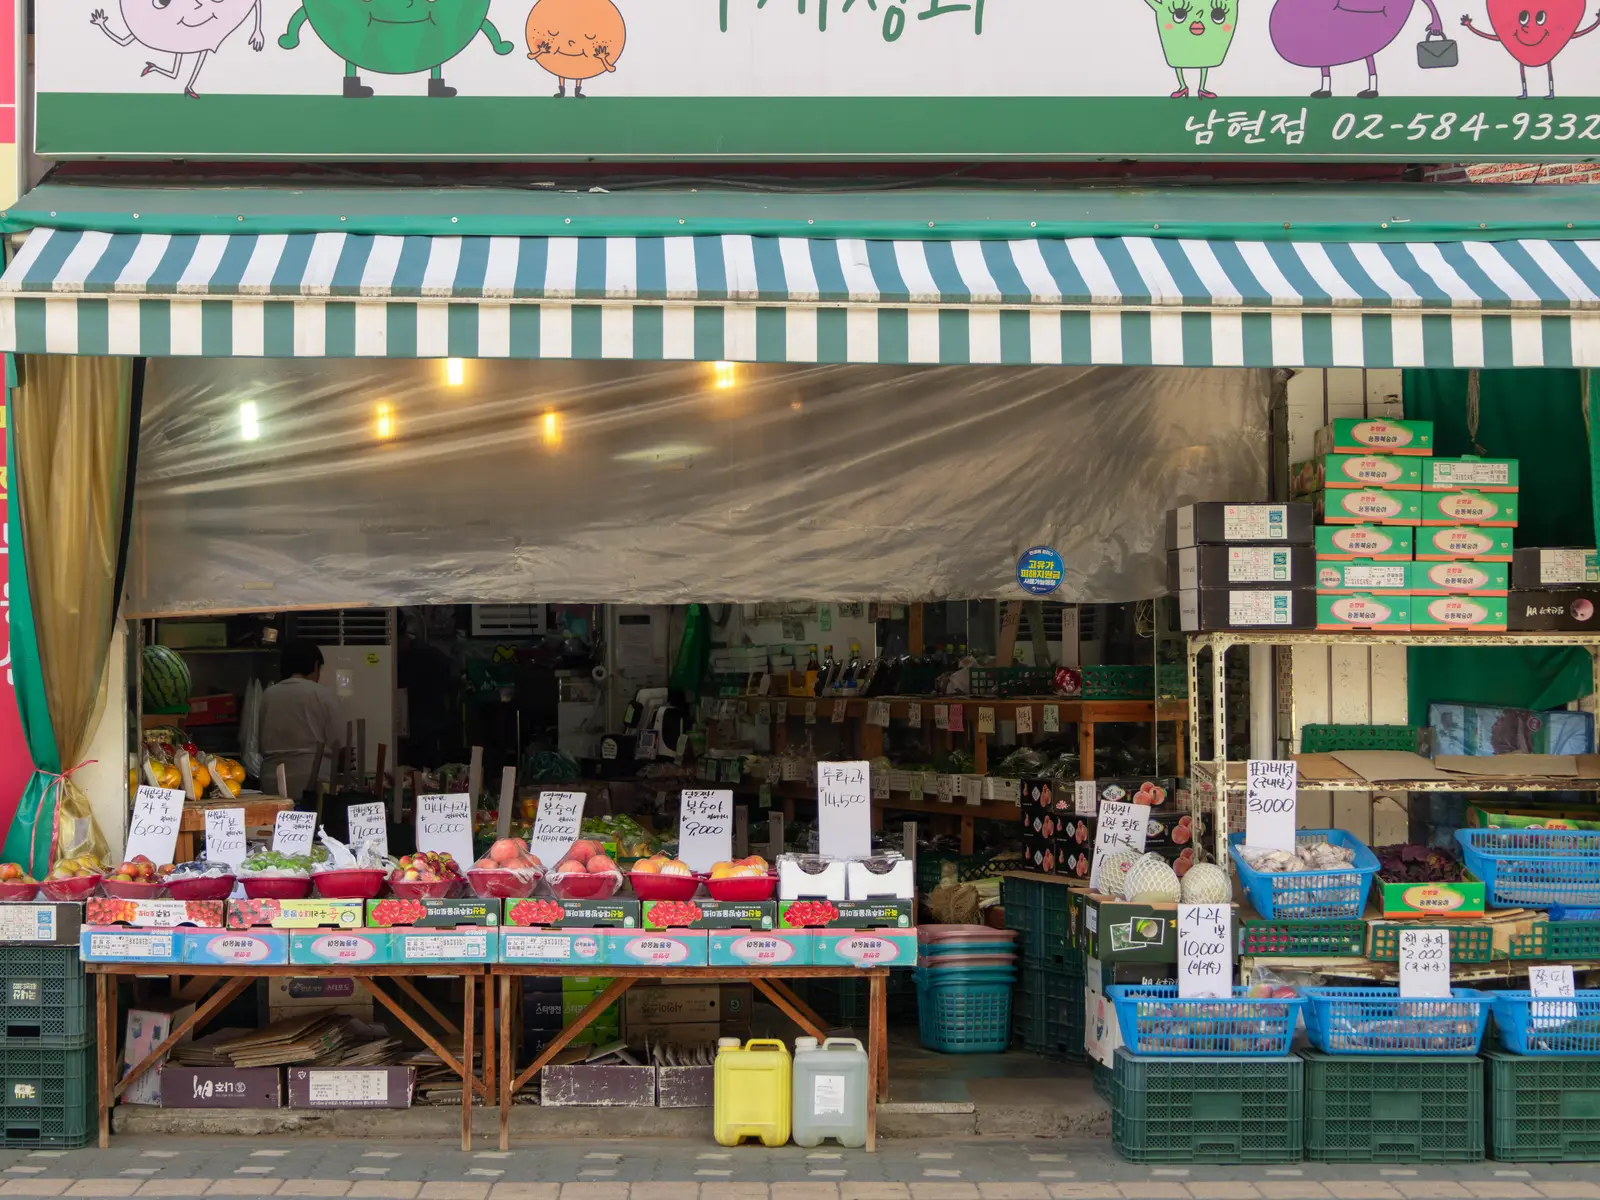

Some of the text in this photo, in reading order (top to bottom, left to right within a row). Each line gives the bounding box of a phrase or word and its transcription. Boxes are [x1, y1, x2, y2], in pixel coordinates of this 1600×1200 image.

[1185, 107, 1600, 145] 남현점 02-584-9332
[1028, 560, 1055, 570] 고유가
[1020, 569, 1061, 579] 피해지원금
[821, 767, 866, 786] 무화과
[1249, 761, 1295, 779] 표고버섯
[424, 800, 469, 814] 미니사과
[543, 802, 578, 816] 복숭아
[685, 800, 724, 815] 복숭아
[1185, 907, 1224, 926] 사과
[13, 990, 37, 1000] 국내산
[214, 1081, 234, 1092] 나주
